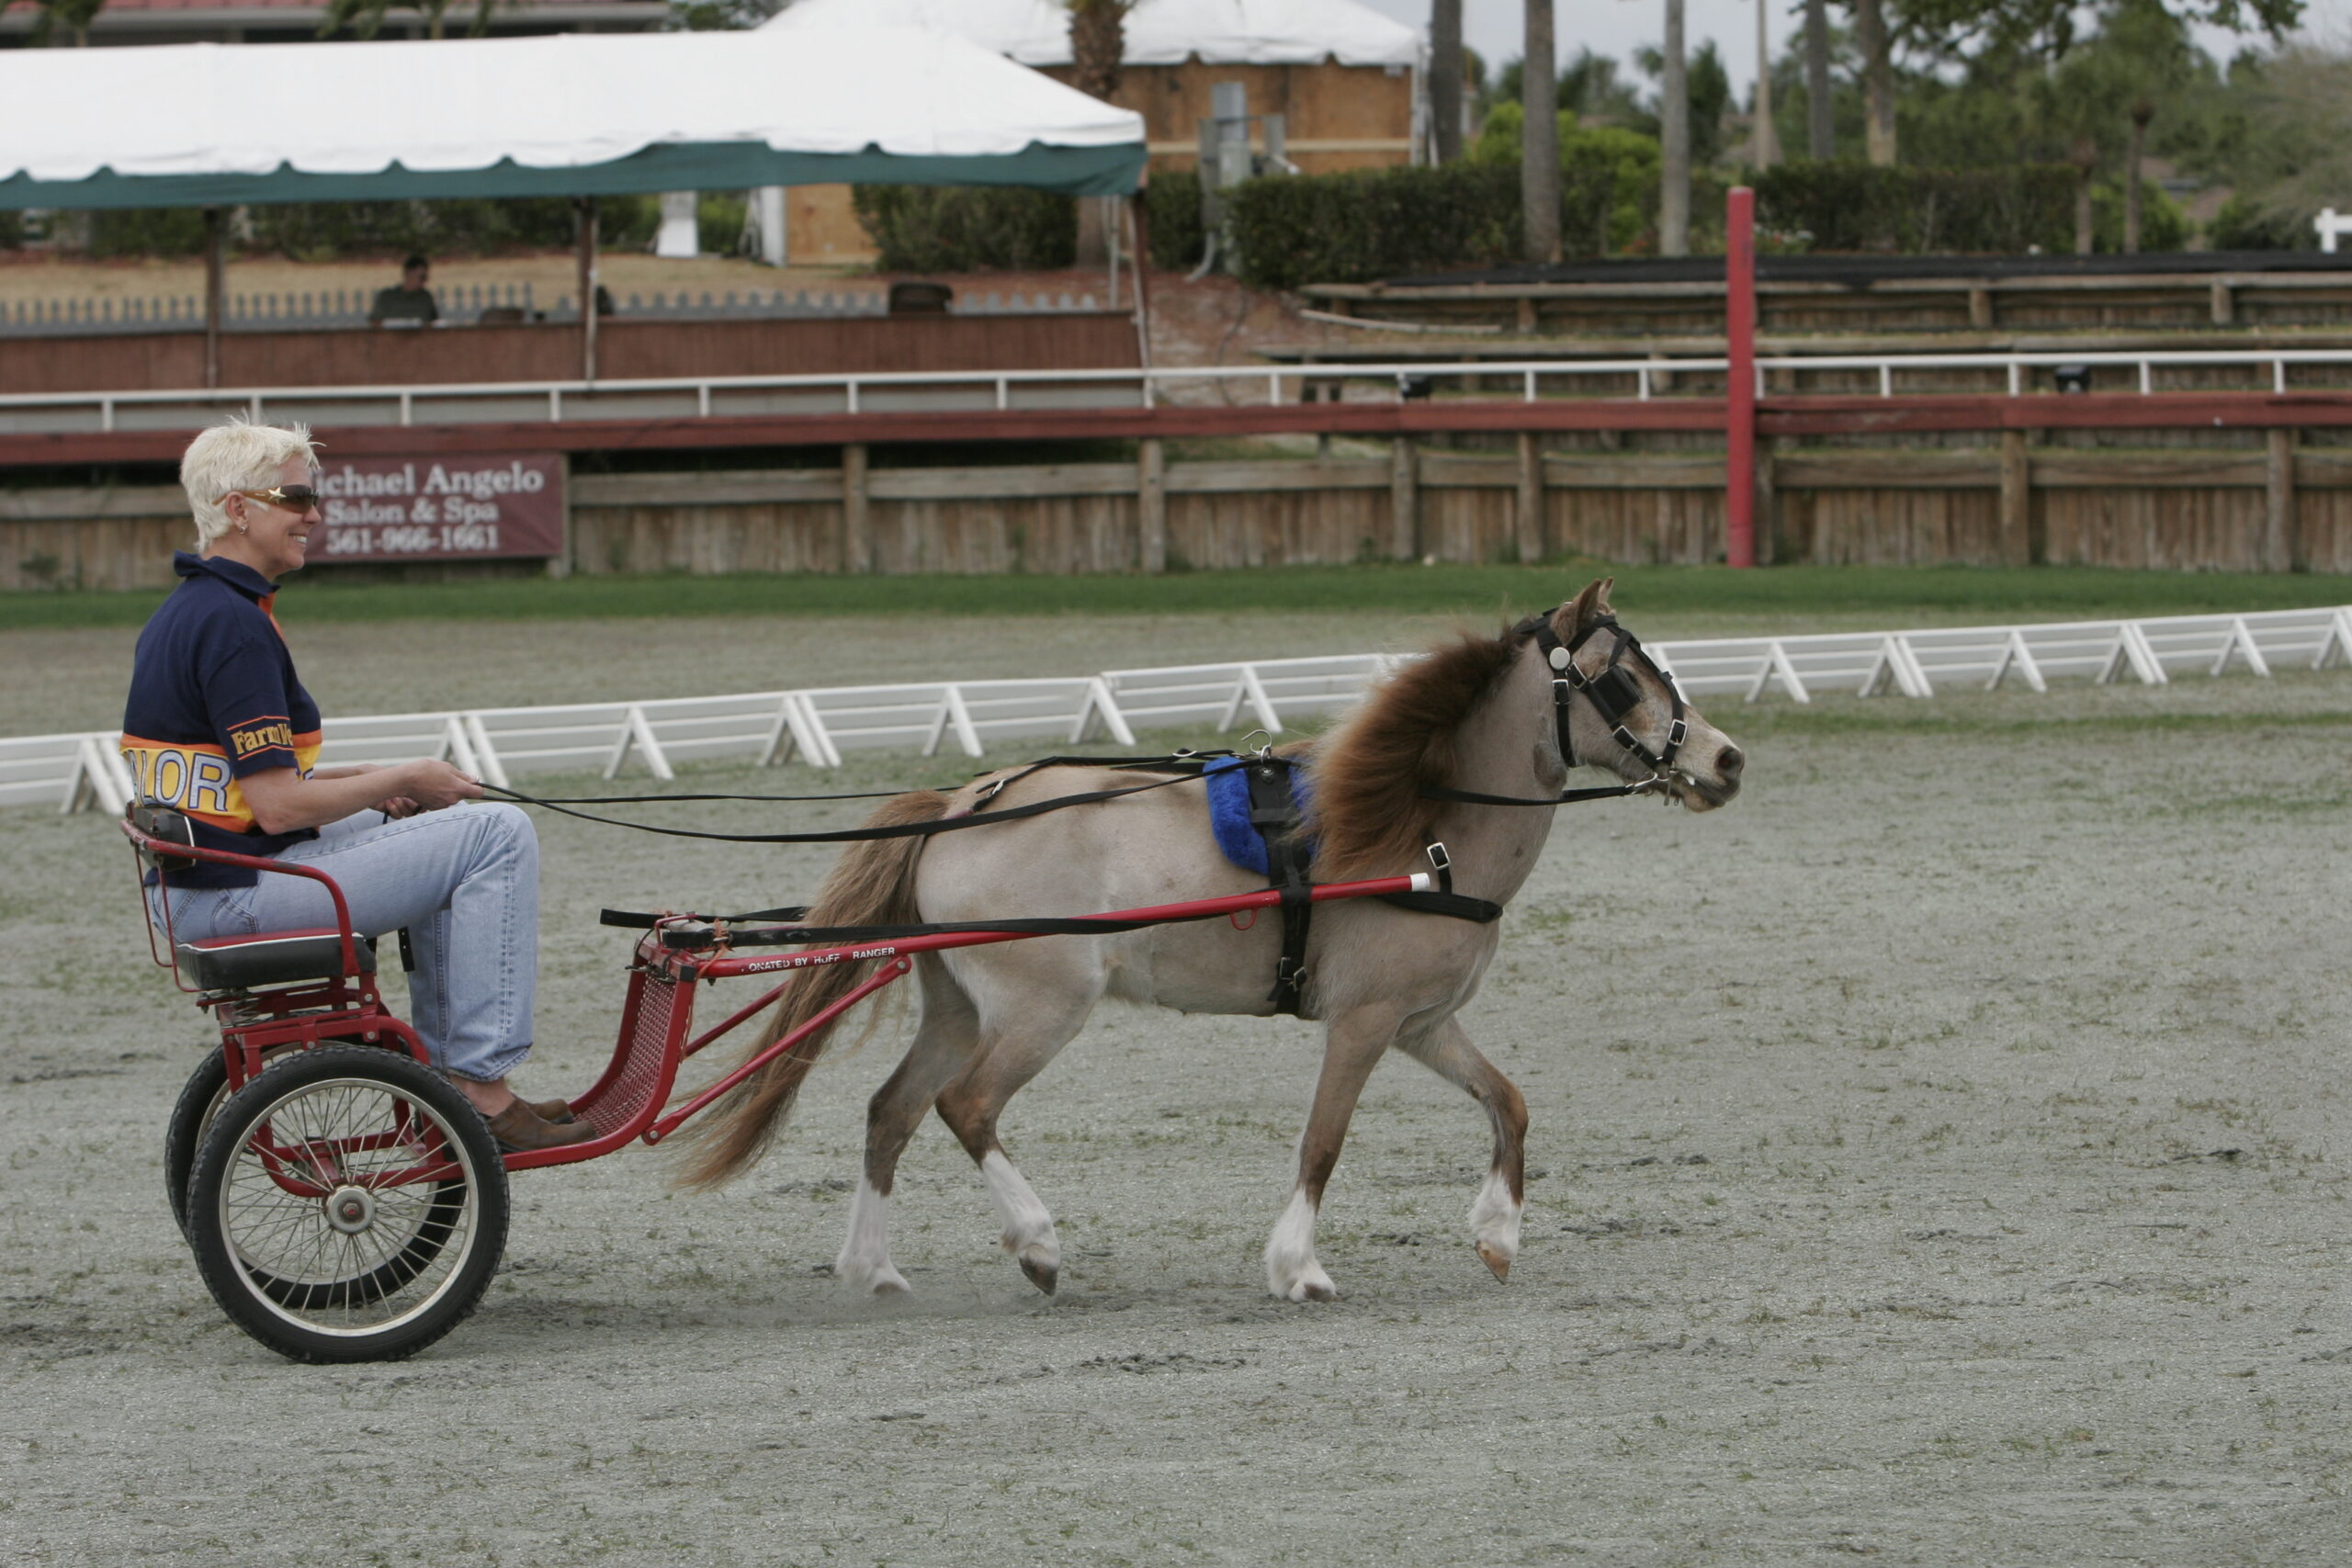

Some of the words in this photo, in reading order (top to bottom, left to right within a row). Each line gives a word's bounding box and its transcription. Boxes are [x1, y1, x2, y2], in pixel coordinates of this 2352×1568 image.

[315, 463, 414, 498] ichael
[423, 461, 545, 500] Angelo
[325, 498, 404, 525] Salon
[411, 497, 436, 524] &
[443, 495, 498, 526] Spa
[744, 960, 790, 972] ONATED
[794, 957, 808, 966] BY
[852, 947, 895, 960] RANGER
